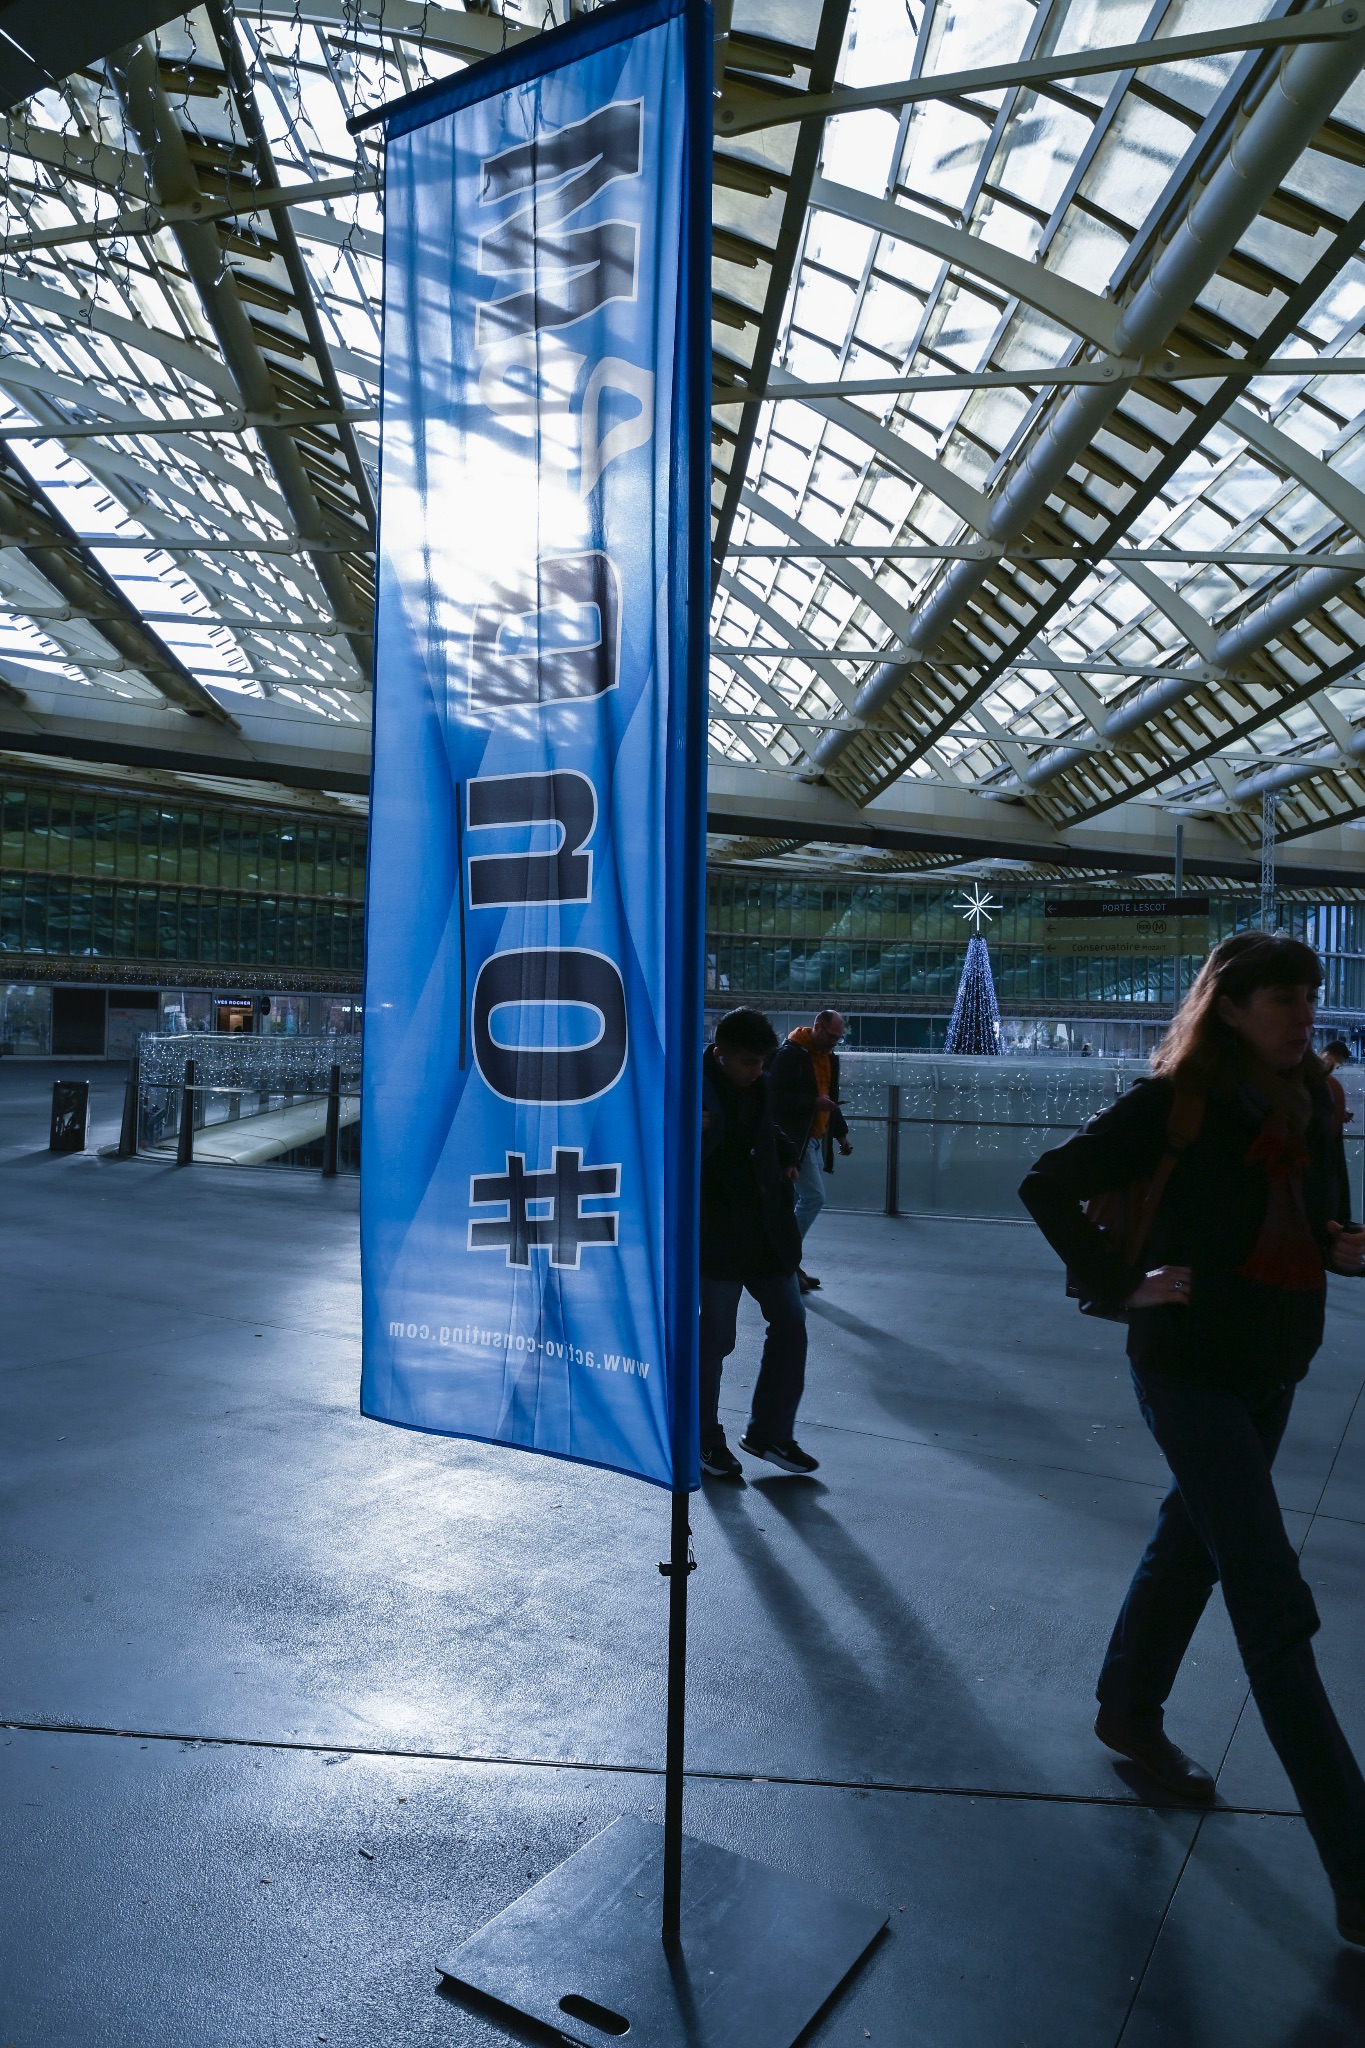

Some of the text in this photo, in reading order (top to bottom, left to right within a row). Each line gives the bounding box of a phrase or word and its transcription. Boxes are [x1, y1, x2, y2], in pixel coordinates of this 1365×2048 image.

[1102, 903, 1167, 912] PORTE LESCOT
[1072, 942, 1140, 951] Conservatoire
